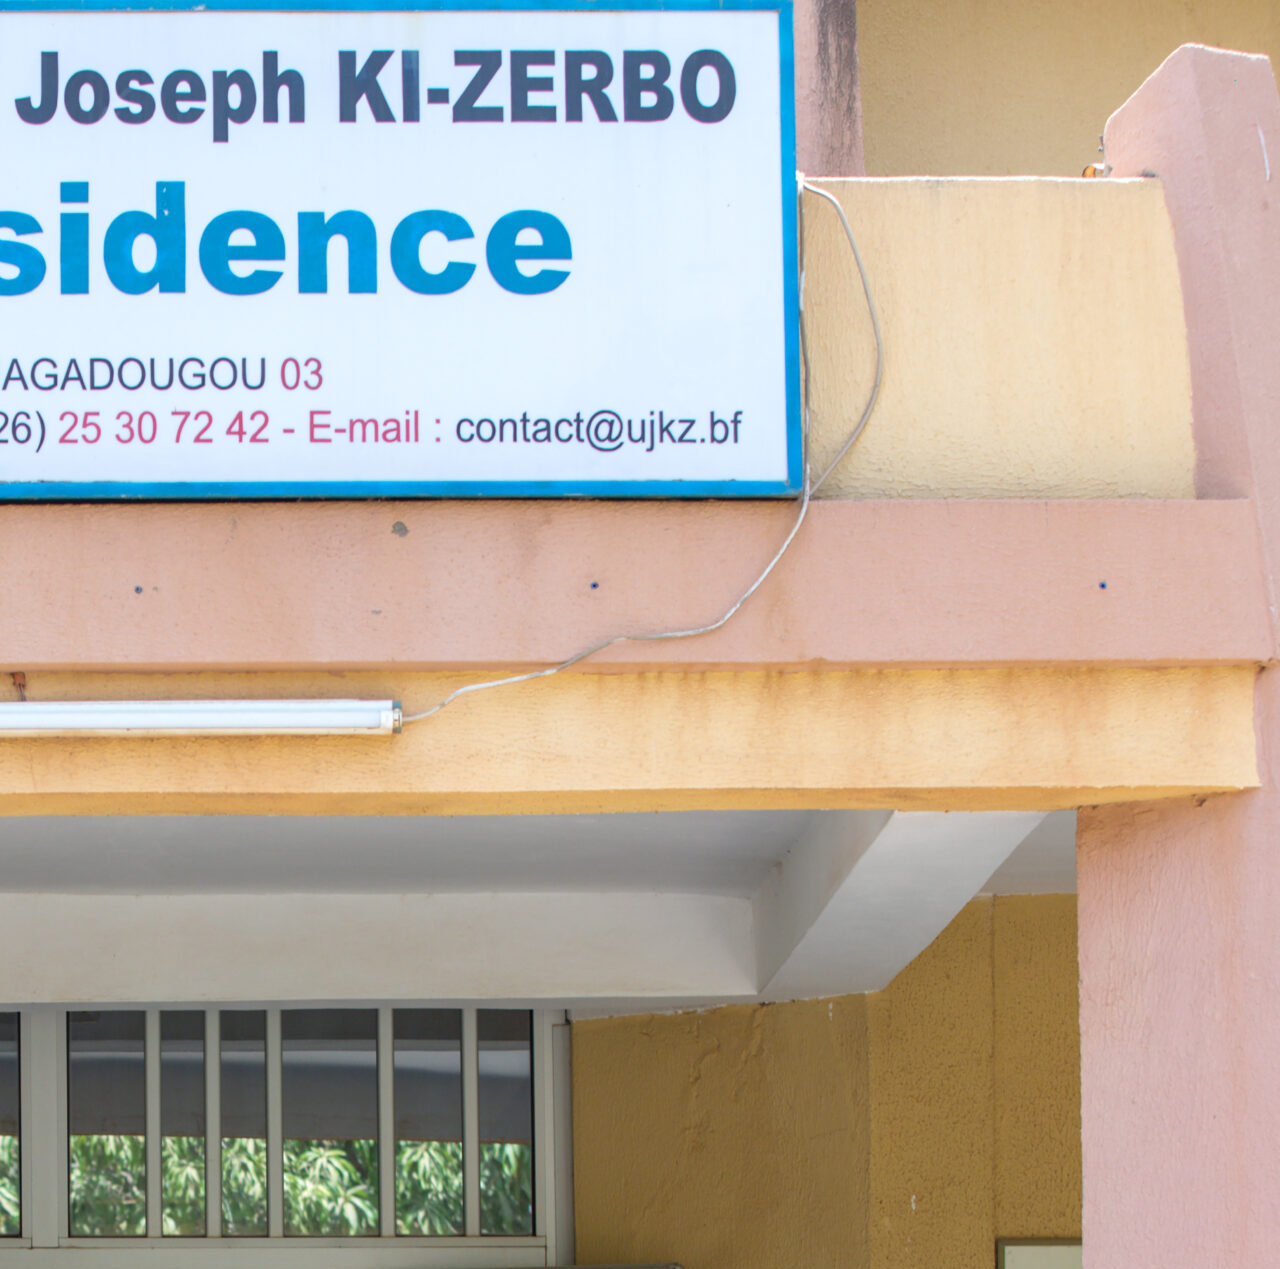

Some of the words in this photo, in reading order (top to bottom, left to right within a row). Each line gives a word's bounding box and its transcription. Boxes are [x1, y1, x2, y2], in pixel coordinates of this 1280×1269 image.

[14, 49, 306, 144] Joseph
[338, 48, 738, 125] KI-ZERBO
[281, 357, 324, 391] 03
[59, 411, 102, 445] 25
[115, 411, 158, 445] 30
[171, 410, 214, 444] 72
[226, 410, 270, 444] 42
[310, 410, 420, 444] E-mail
[456, 409, 744, 453] contact@ujkz.bf
